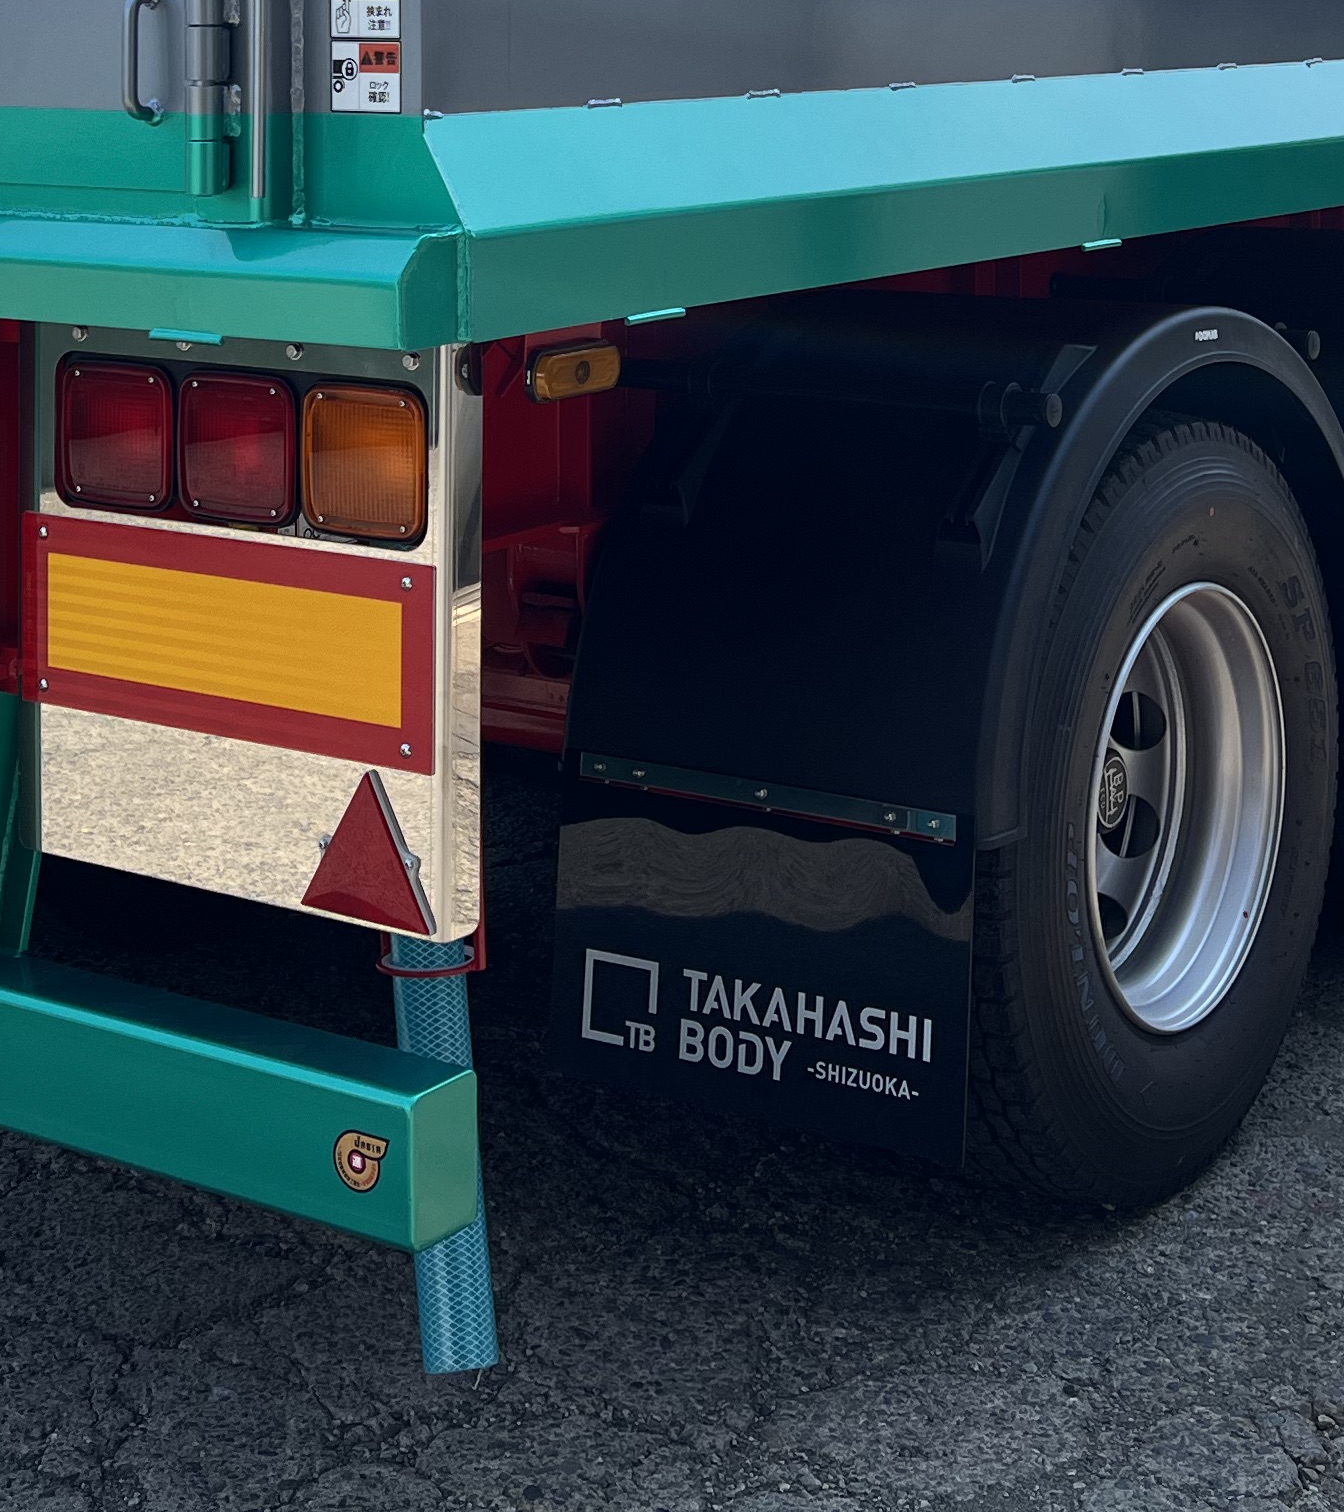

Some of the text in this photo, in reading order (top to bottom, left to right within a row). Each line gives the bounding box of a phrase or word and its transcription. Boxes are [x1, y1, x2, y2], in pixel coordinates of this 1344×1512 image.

[373, 51, 397, 66] 警告
[369, 81, 389, 90] ロック
[683, 968, 932, 1063] TAKAHASHI
[625, 1020, 656, 1053] TB
[679, 1018, 919, 1100] BODY -SHIZUOKA-
